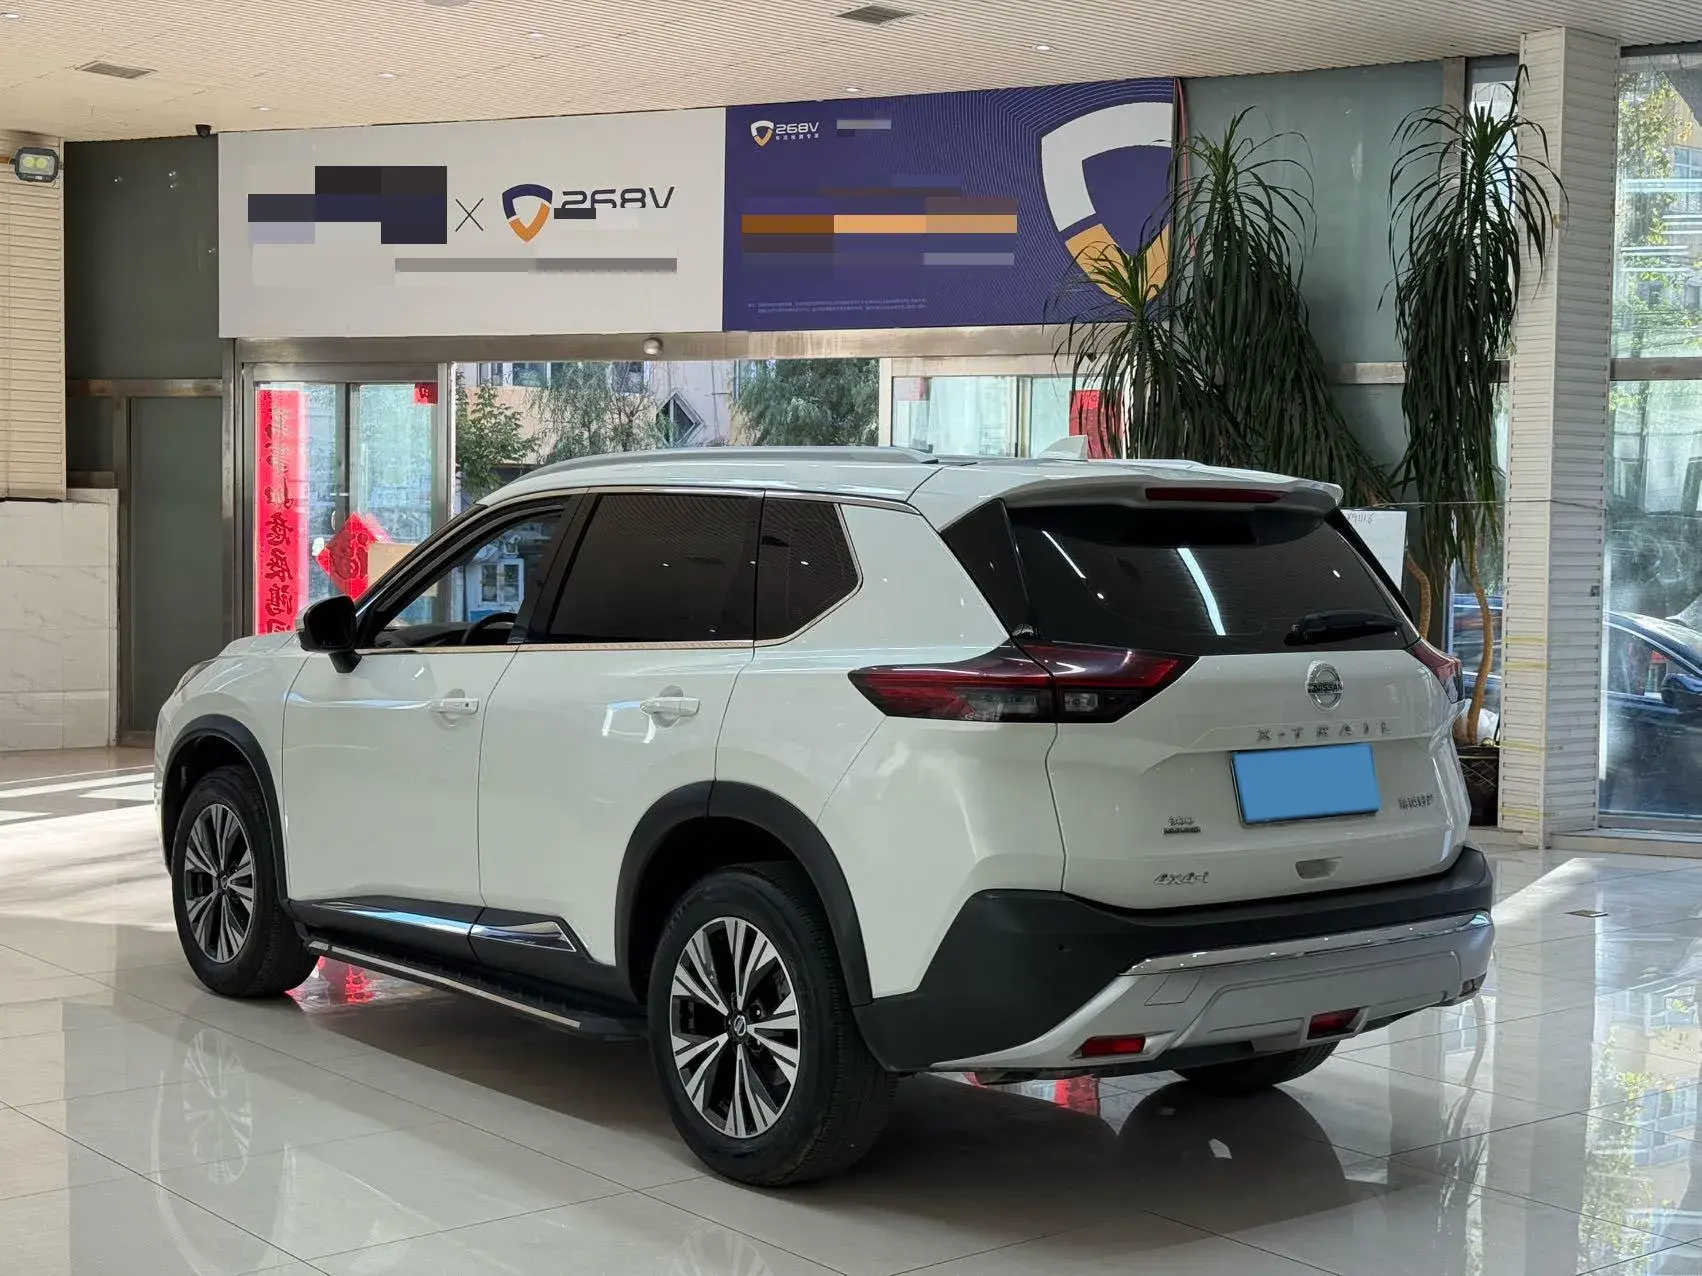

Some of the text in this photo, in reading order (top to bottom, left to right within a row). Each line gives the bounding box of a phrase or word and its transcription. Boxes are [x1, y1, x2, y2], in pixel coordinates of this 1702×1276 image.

[776, 122, 819, 134] 268V
[561, 186, 675, 209] 268V
[1312, 682, 1343, 694] NISSAN
[1256, 722, 1393, 743] X-TRAIL
